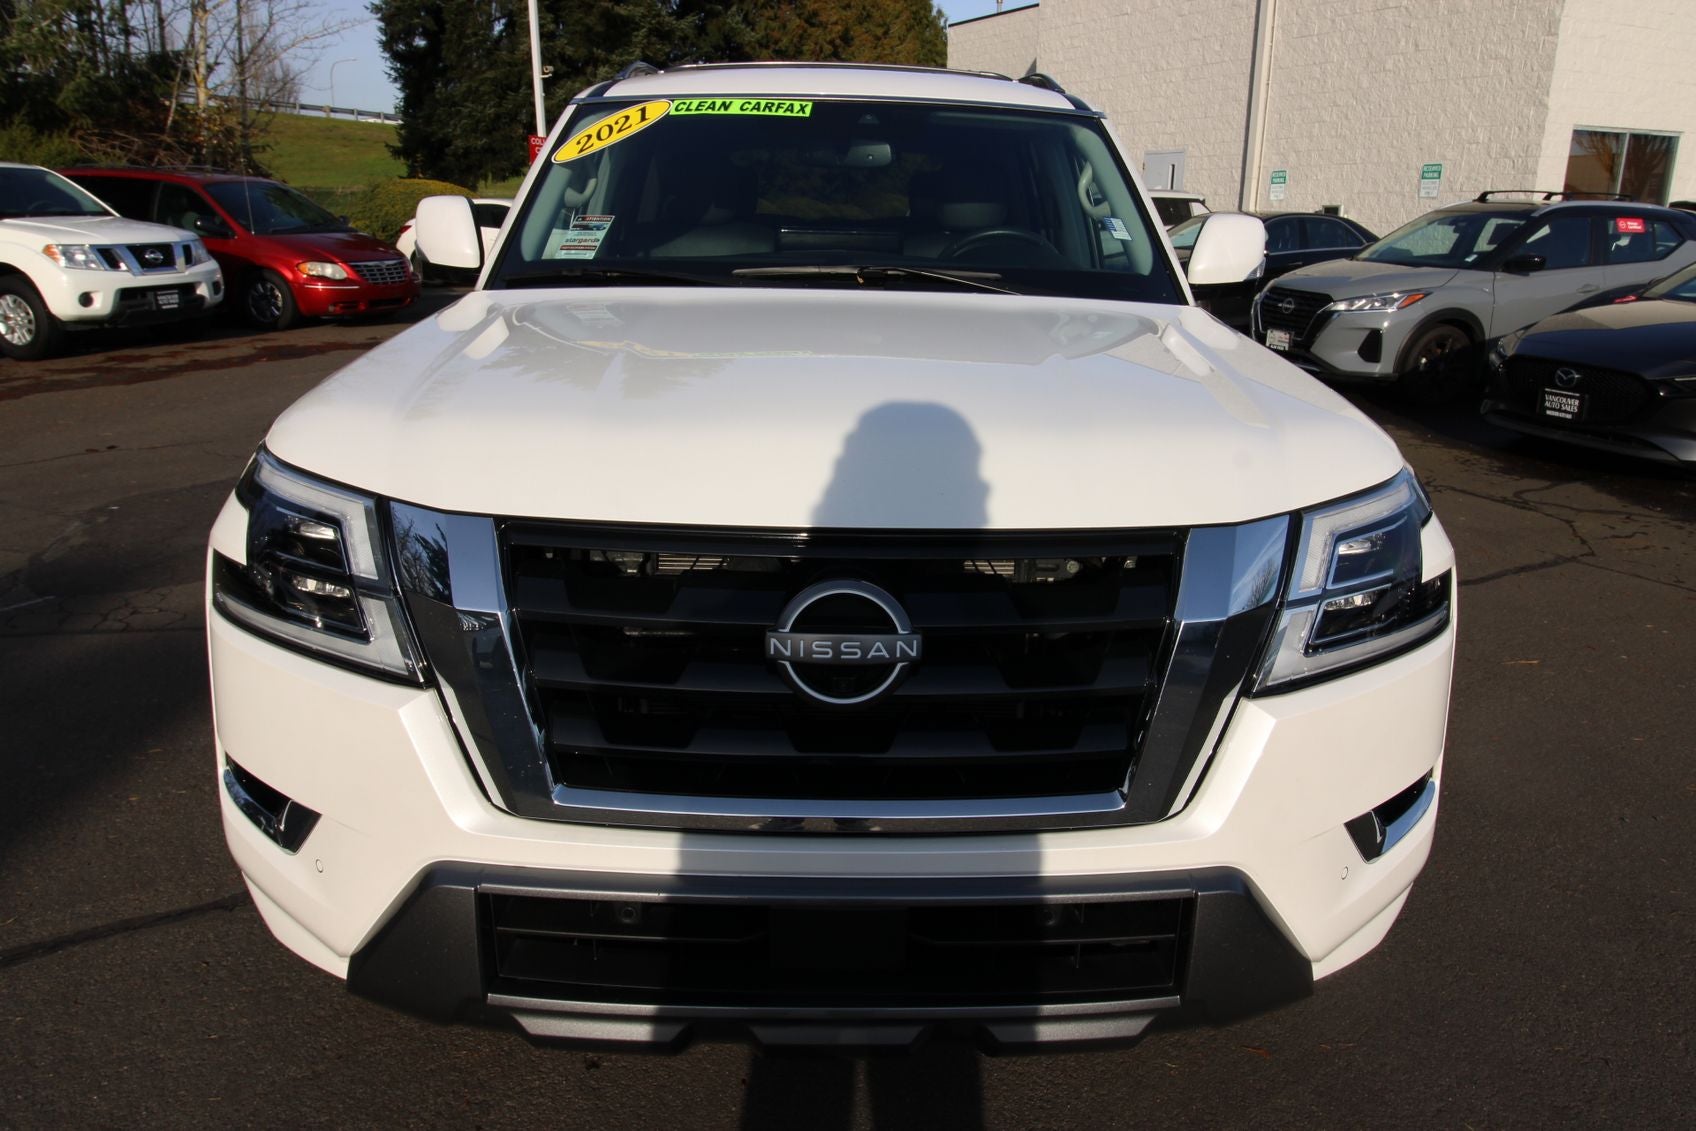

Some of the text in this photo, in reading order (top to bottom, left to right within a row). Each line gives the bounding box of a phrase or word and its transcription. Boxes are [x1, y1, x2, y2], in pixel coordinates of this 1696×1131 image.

[674, 100, 810, 115] CLEAN CARFAX
[576, 105, 650, 154] 2021
[1544, 401, 1578, 413] AUTO SALES
[1545, 393, 1580, 407] VANCOUVER
[769, 637, 918, 660] NISSAN
